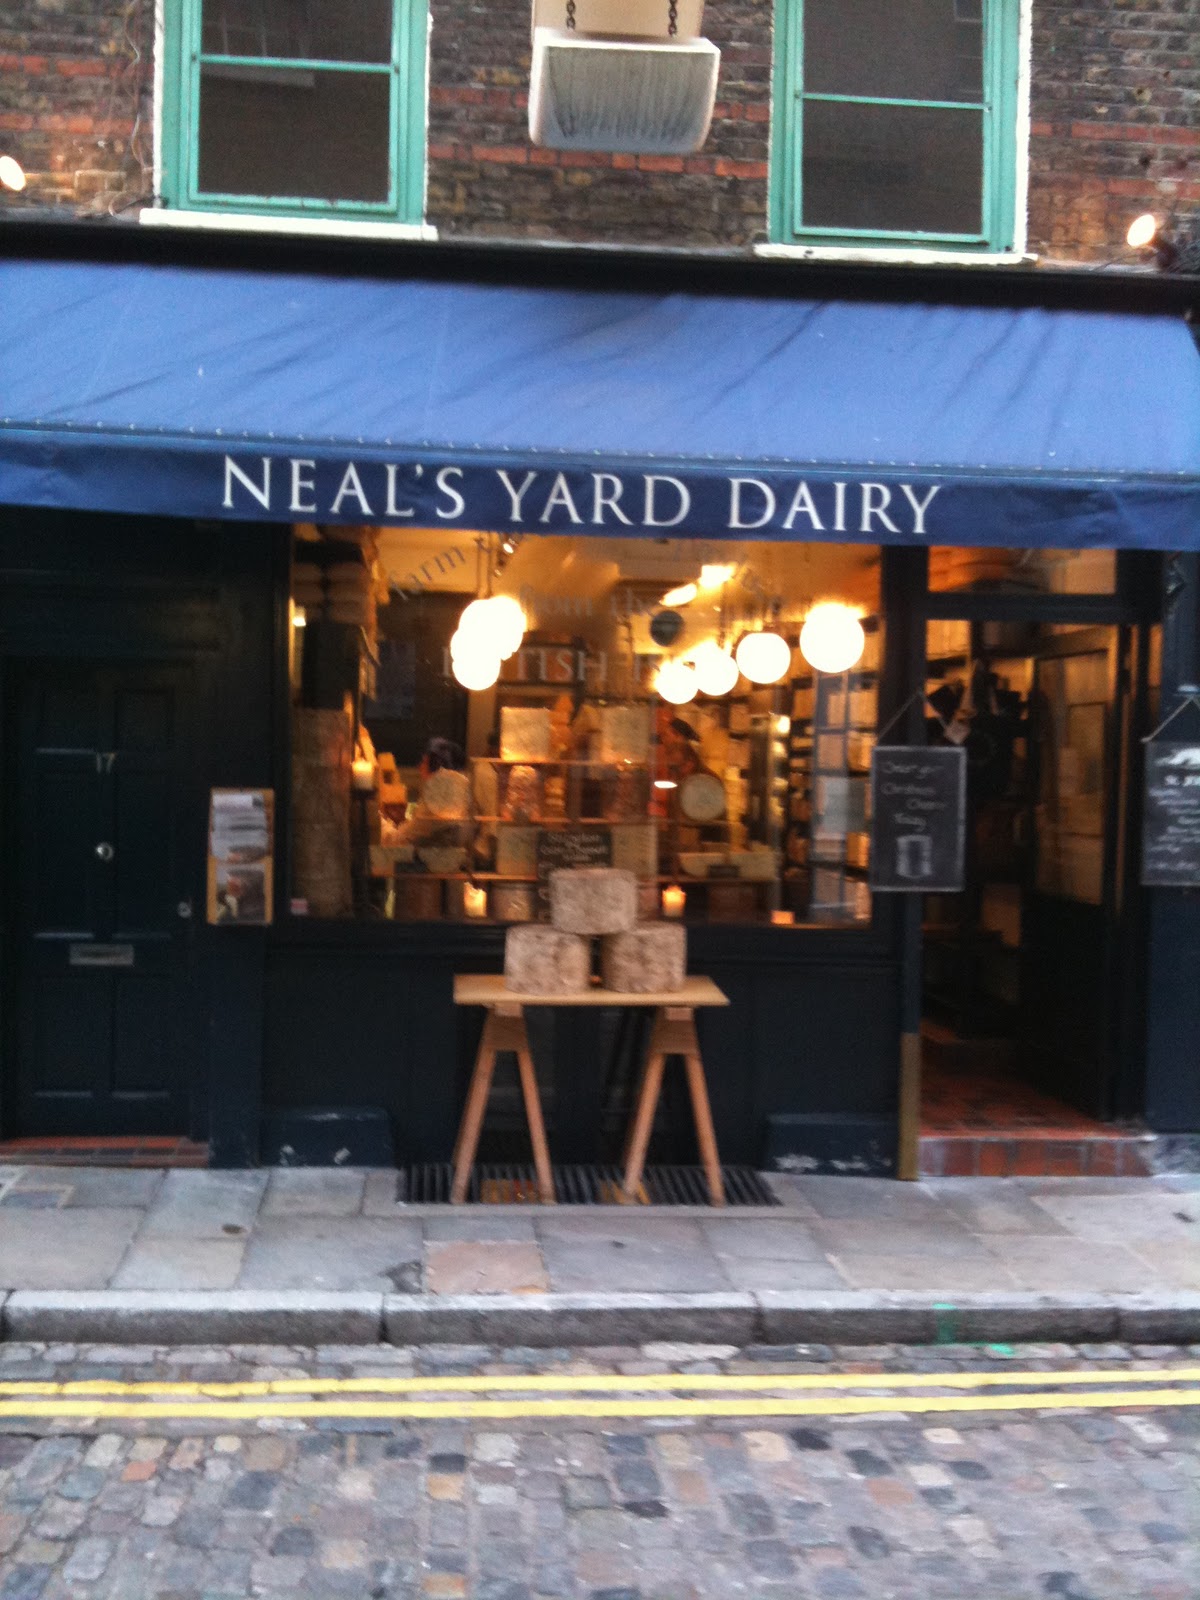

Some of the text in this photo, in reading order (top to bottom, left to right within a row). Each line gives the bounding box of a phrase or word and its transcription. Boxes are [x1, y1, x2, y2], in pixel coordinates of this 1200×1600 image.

[221, 455, 941, 535] NEAL'S YARD DAIRY
